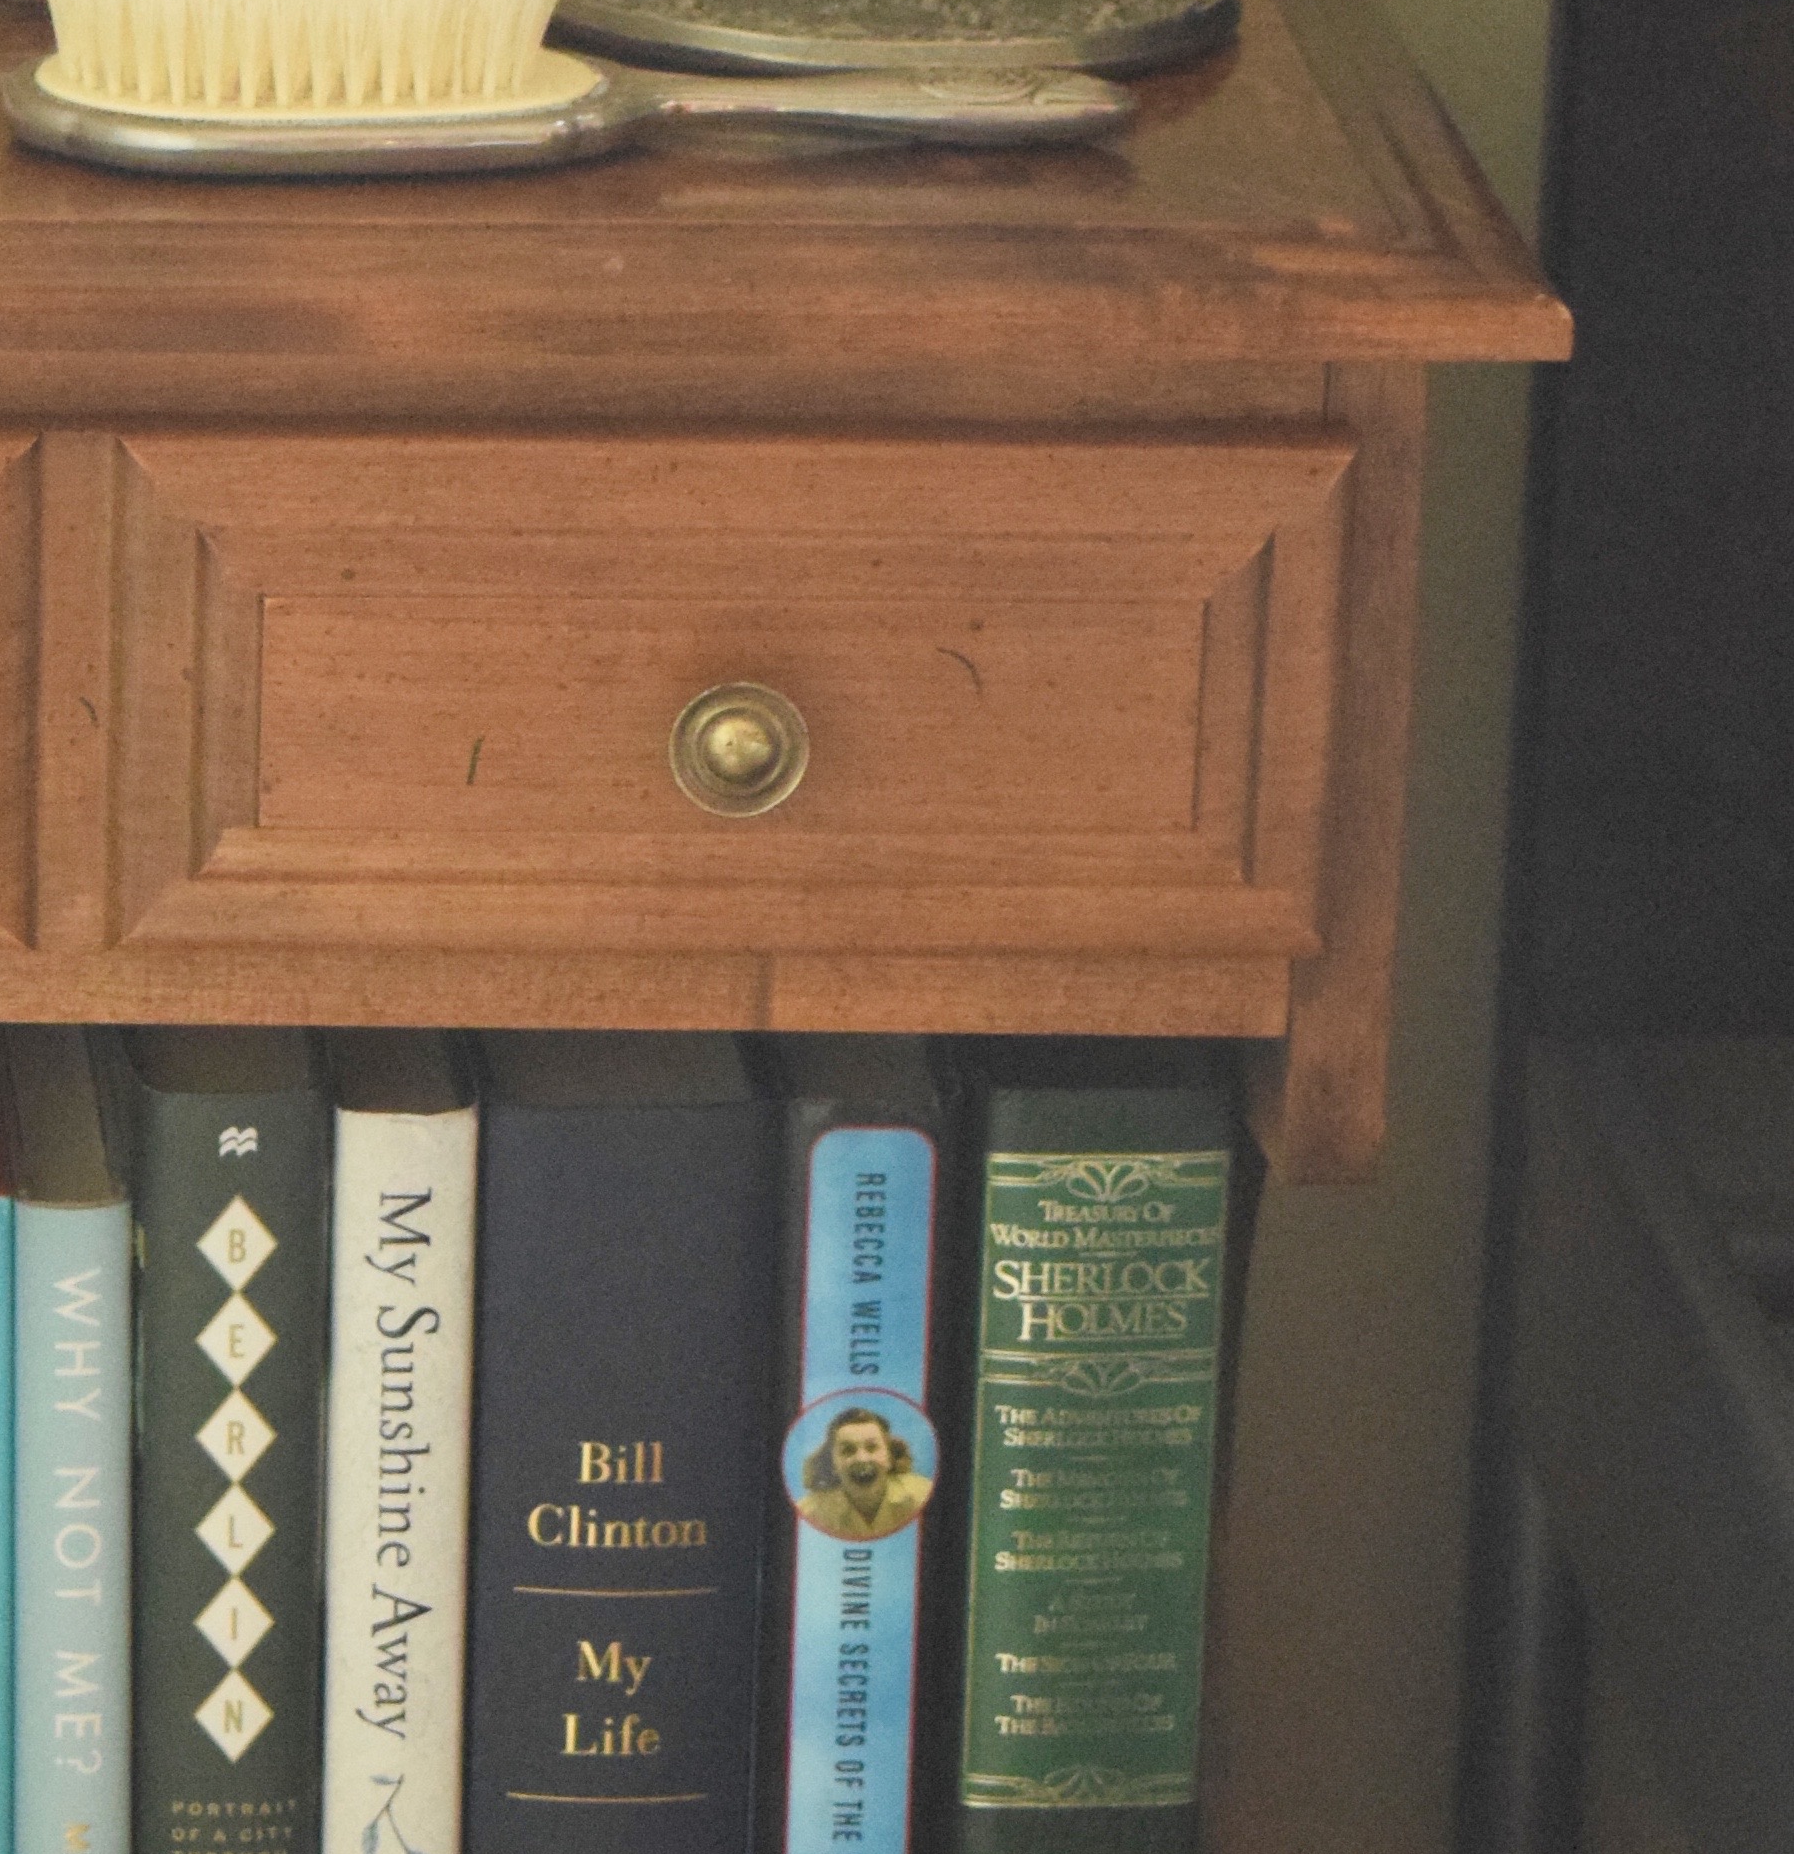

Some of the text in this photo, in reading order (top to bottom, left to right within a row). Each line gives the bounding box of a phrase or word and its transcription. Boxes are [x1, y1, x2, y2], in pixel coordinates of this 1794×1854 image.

[849, 1173, 887, 1377] REBECCA WELLS
[993, 1258, 1210, 1300] SHERLOCK
[1017, 1301, 1188, 1341] HOLMES
[355, 1188, 441, 1741] My Sunshine Away
[577, 1441, 665, 1485] Bill
[53, 1267, 102, 1776] WHY NOT ME?
[526, 1502, 708, 1548] Clinton
[839, 1547, 873, 1631] DIVINE
[576, 1640, 653, 1696] My
[835, 1644, 869, 1747] SECRETS
[562, 1713, 661, 1757] Life
[832, 1759, 865, 1790] OF
[172, 1799, 297, 1817] PORTRAIT
[831, 1798, 864, 1842] THE
[171, 1826, 293, 1844] OF A CITY
